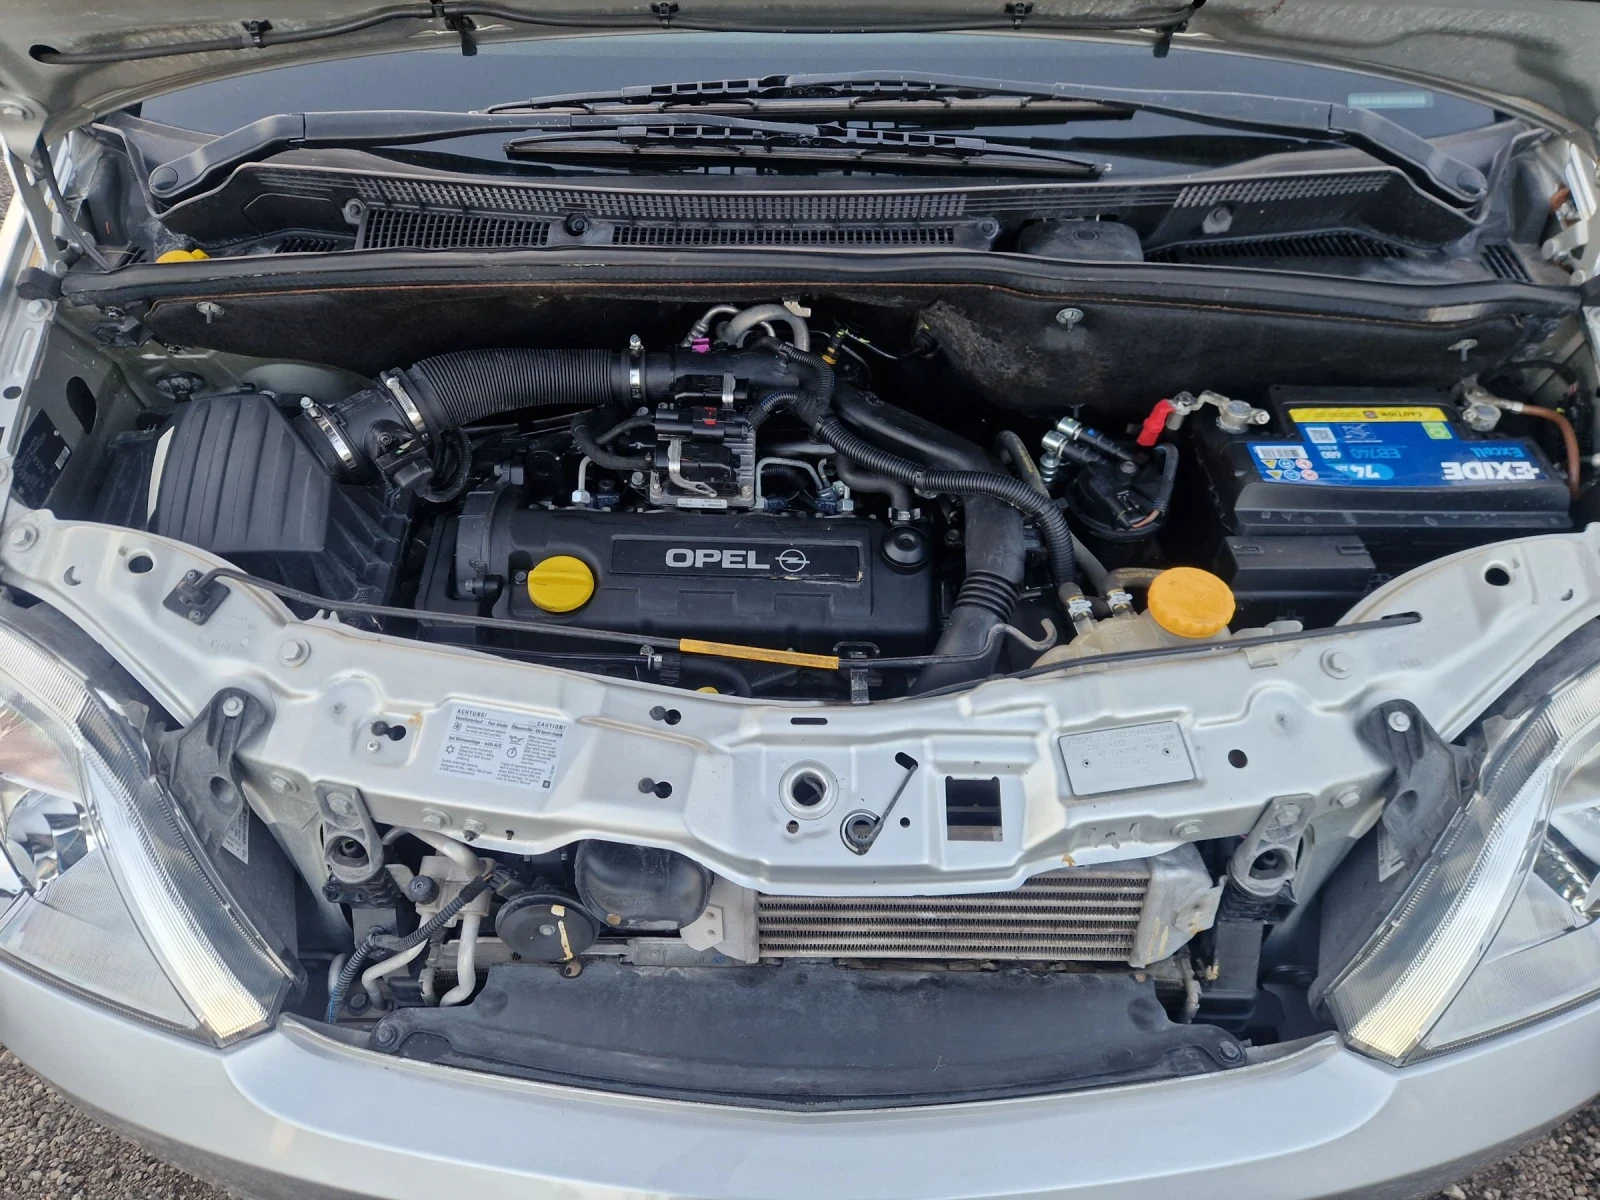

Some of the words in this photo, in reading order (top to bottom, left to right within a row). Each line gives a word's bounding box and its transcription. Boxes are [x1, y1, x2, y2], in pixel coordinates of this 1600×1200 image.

[1350, 448, 1402, 459] EB740
[1470, 446, 1525, 458] Excell
[1349, 464, 1381, 478] 74
[1440, 461, 1540, 480] EXIDE
[665, 548, 770, 569] OPEL
[457, 709, 488, 718] ACHTUNG!
[537, 721, 566, 730] CAUTION!
